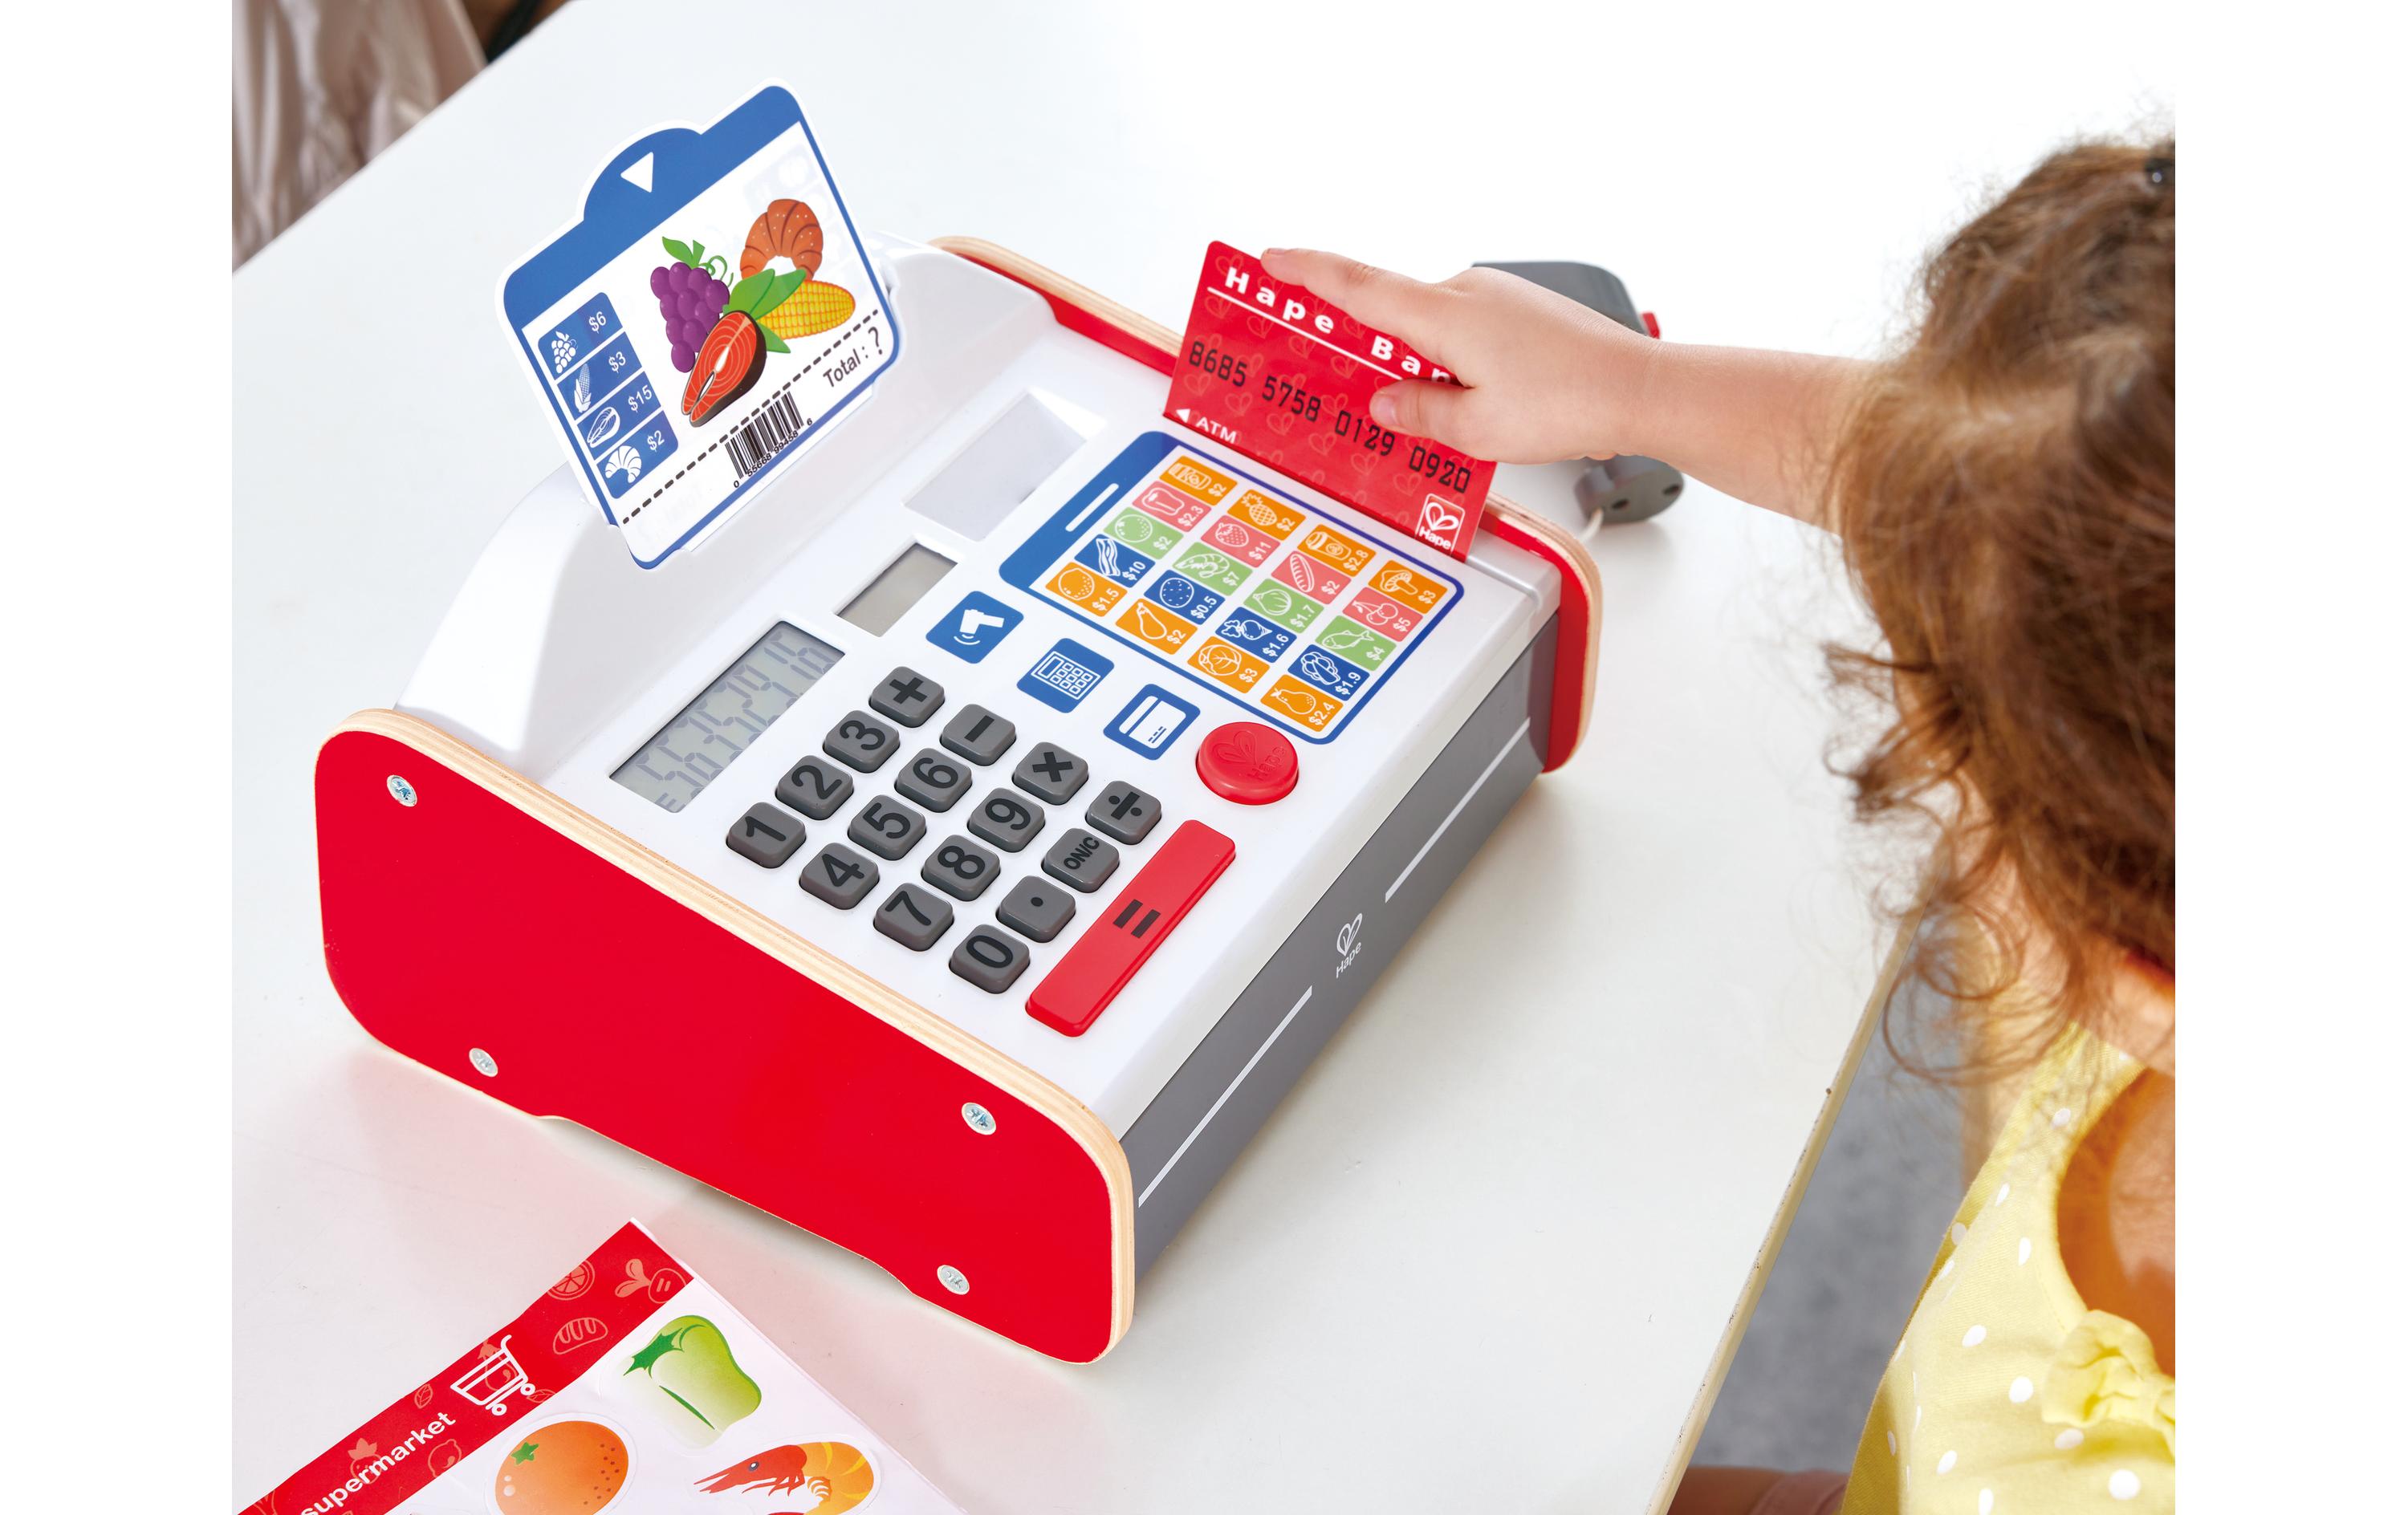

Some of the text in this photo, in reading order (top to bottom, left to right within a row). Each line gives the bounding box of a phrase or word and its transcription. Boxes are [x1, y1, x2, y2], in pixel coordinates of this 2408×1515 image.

[588, 311, 607, 334] $6
[1224, 266, 1451, 383] Hape Ban
[608, 351, 627, 373] $3
[822, 348, 861, 388] Total
[868, 326, 884, 355] ?
[628, 385, 653, 413] $15
[1189, 340, 1471, 494] 8685 5758 0129 0920
[647, 430, 665, 453] $2
[1195, 416, 1237, 445] ATM
[733, 479, 740, 489] 0
[746, 453, 772, 477] 55668
[806, 417, 813, 426] 6
[1208, 483, 1227, 497] $2
[1178, 505, 1205, 527] $2.3
[1276, 517, 1296, 531] $2
[1153, 536, 1173, 550] $2
[1418, 526, 1452, 550] Hape
[1248, 541, 1272, 562] $11
[1343, 550, 1370, 572] $2.8
[1122, 561, 1147, 581] $10
[1222, 571, 1240, 585] $7
[1092, 587, 1121, 611] $1.5
[1322, 581, 1341, 595] $2
[1418, 590, 1438, 604] $3
[1190, 595, 1218, 619] $0.5
[1290, 604, 1317, 629] $1.7
[1393, 617, 1413, 632] $5
[1166, 629, 1187, 645] $2
[1263, 633, 1290, 657] $1.6
[1366, 647, 1385, 662] $4
[1239, 668, 1259, 684] $3
[1335, 672, 1362, 696] $1.9
[1308, 702, 1336, 725] $2.4
[839, 720, 886, 751] 3
[913, 758, 958, 789] 6
[1247, 745, 1286, 782] Hape
[791, 765, 842, 800] 2
[862, 802, 911, 839] 5
[985, 798, 1031, 831] 9
[745, 815, 787, 842] 1
[938, 845, 986, 879] 8
[1064, 836, 1100, 871] ON/C
[821, 854, 865, 887] 4
[885, 890, 932, 926] 7
[966, 935, 1014, 969] 0
[1336, 941, 1362, 979] Hape
[300, 1411, 457, 1515] supermarket
